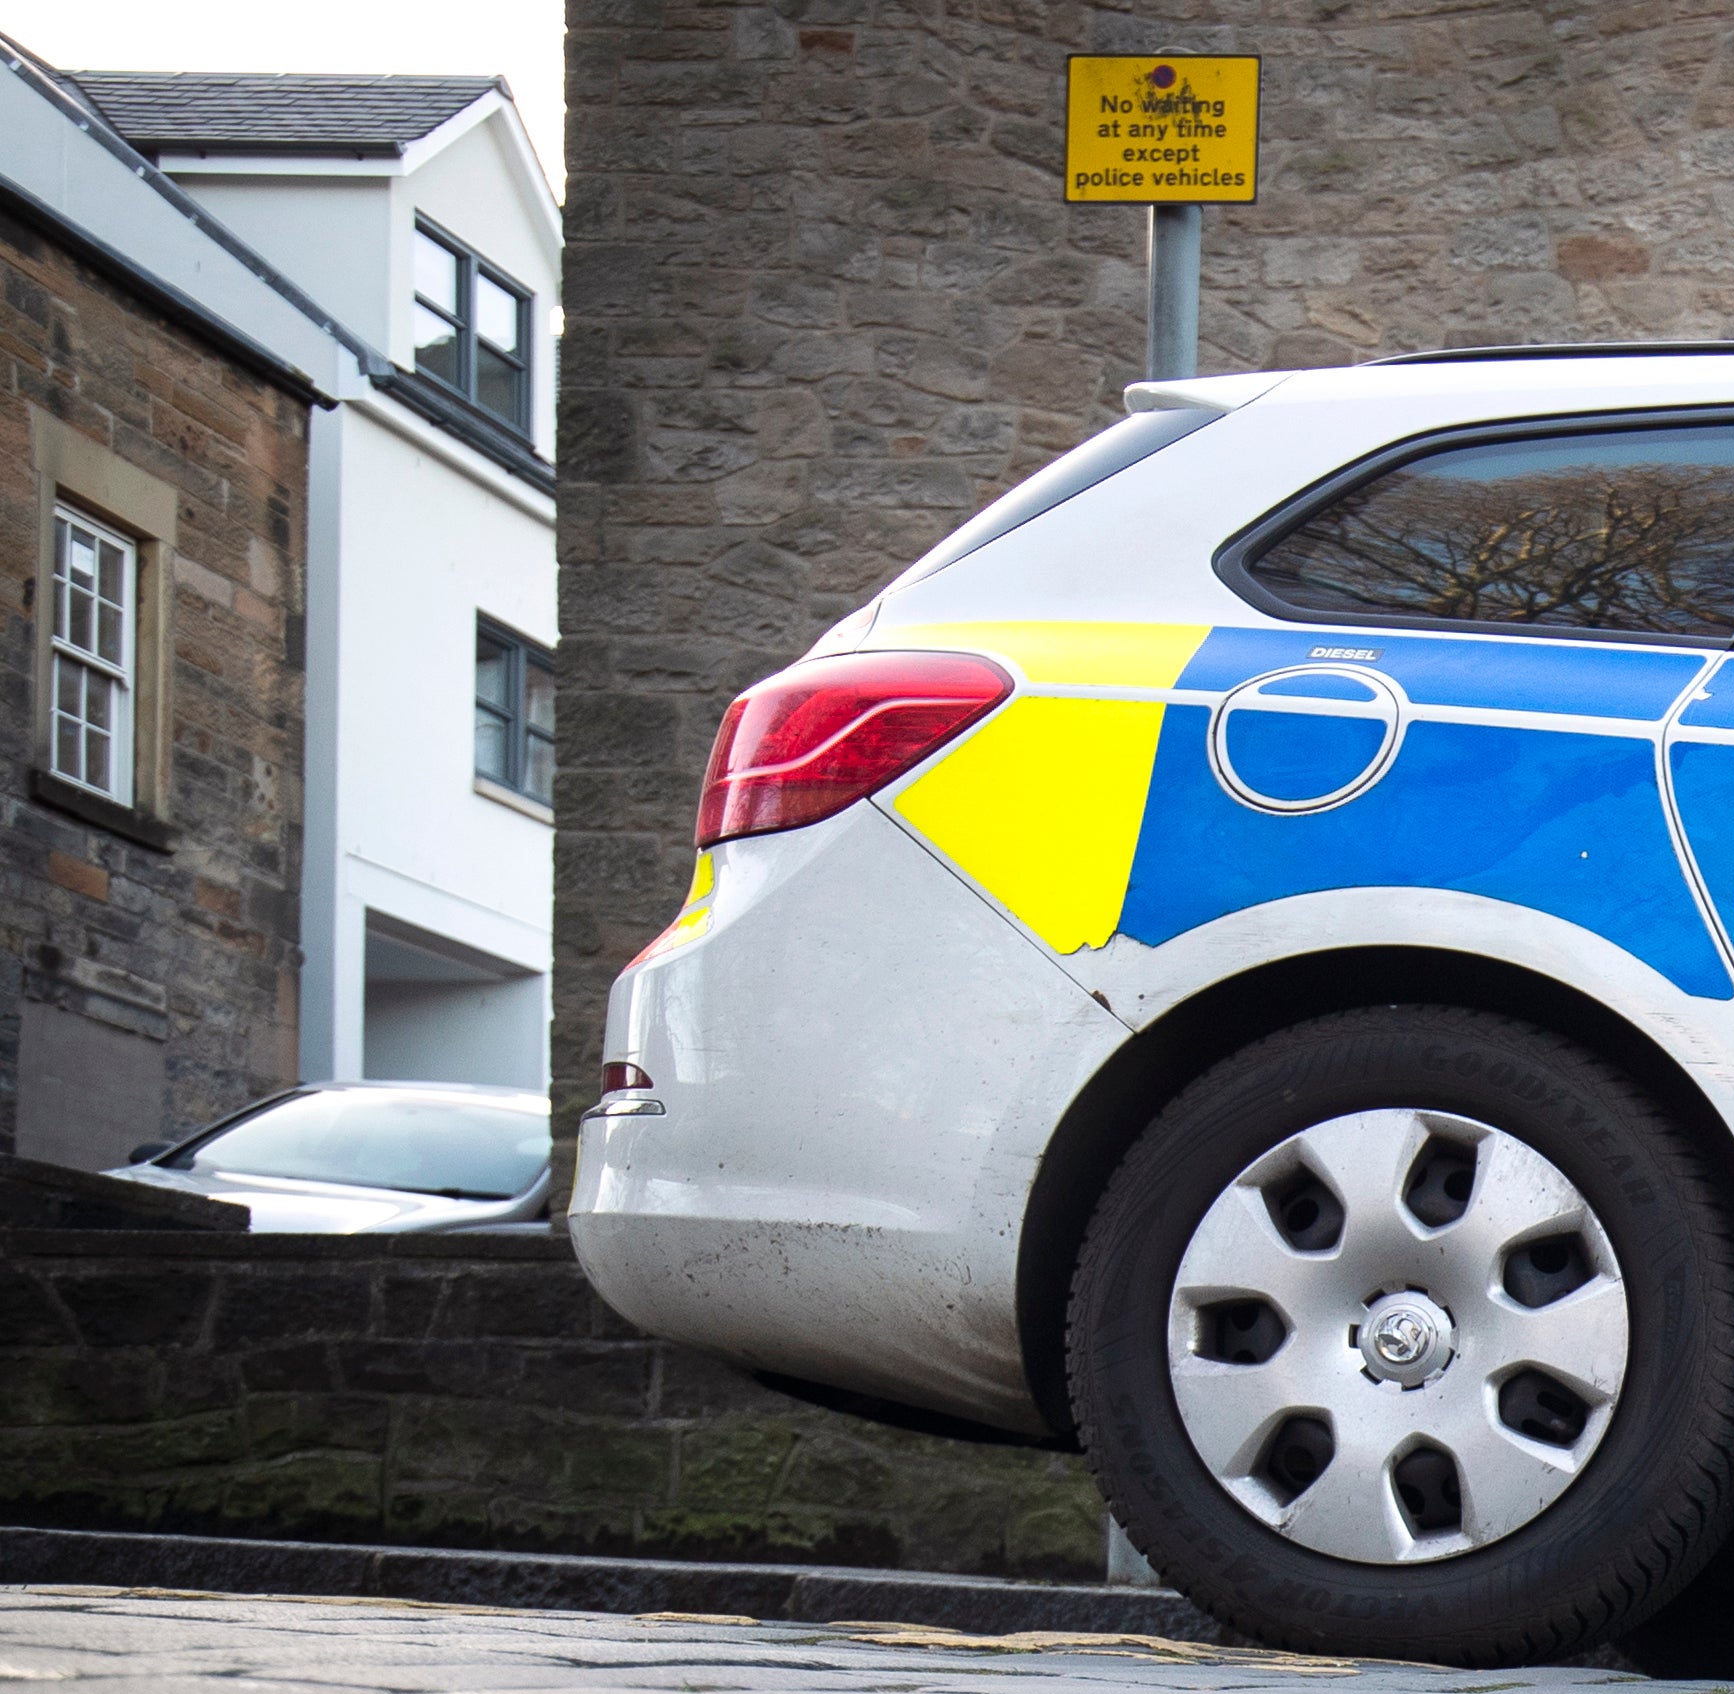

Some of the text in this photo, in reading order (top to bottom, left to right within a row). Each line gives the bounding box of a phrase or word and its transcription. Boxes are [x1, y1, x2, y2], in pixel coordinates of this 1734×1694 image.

[1101, 94, 1225, 118] No waiting
[1098, 119, 1227, 141] at any time
[1123, 145, 1200, 165] except
[1075, 168, 1246, 189] police vehicles
[1311, 647, 1377, 660] DIESEL
